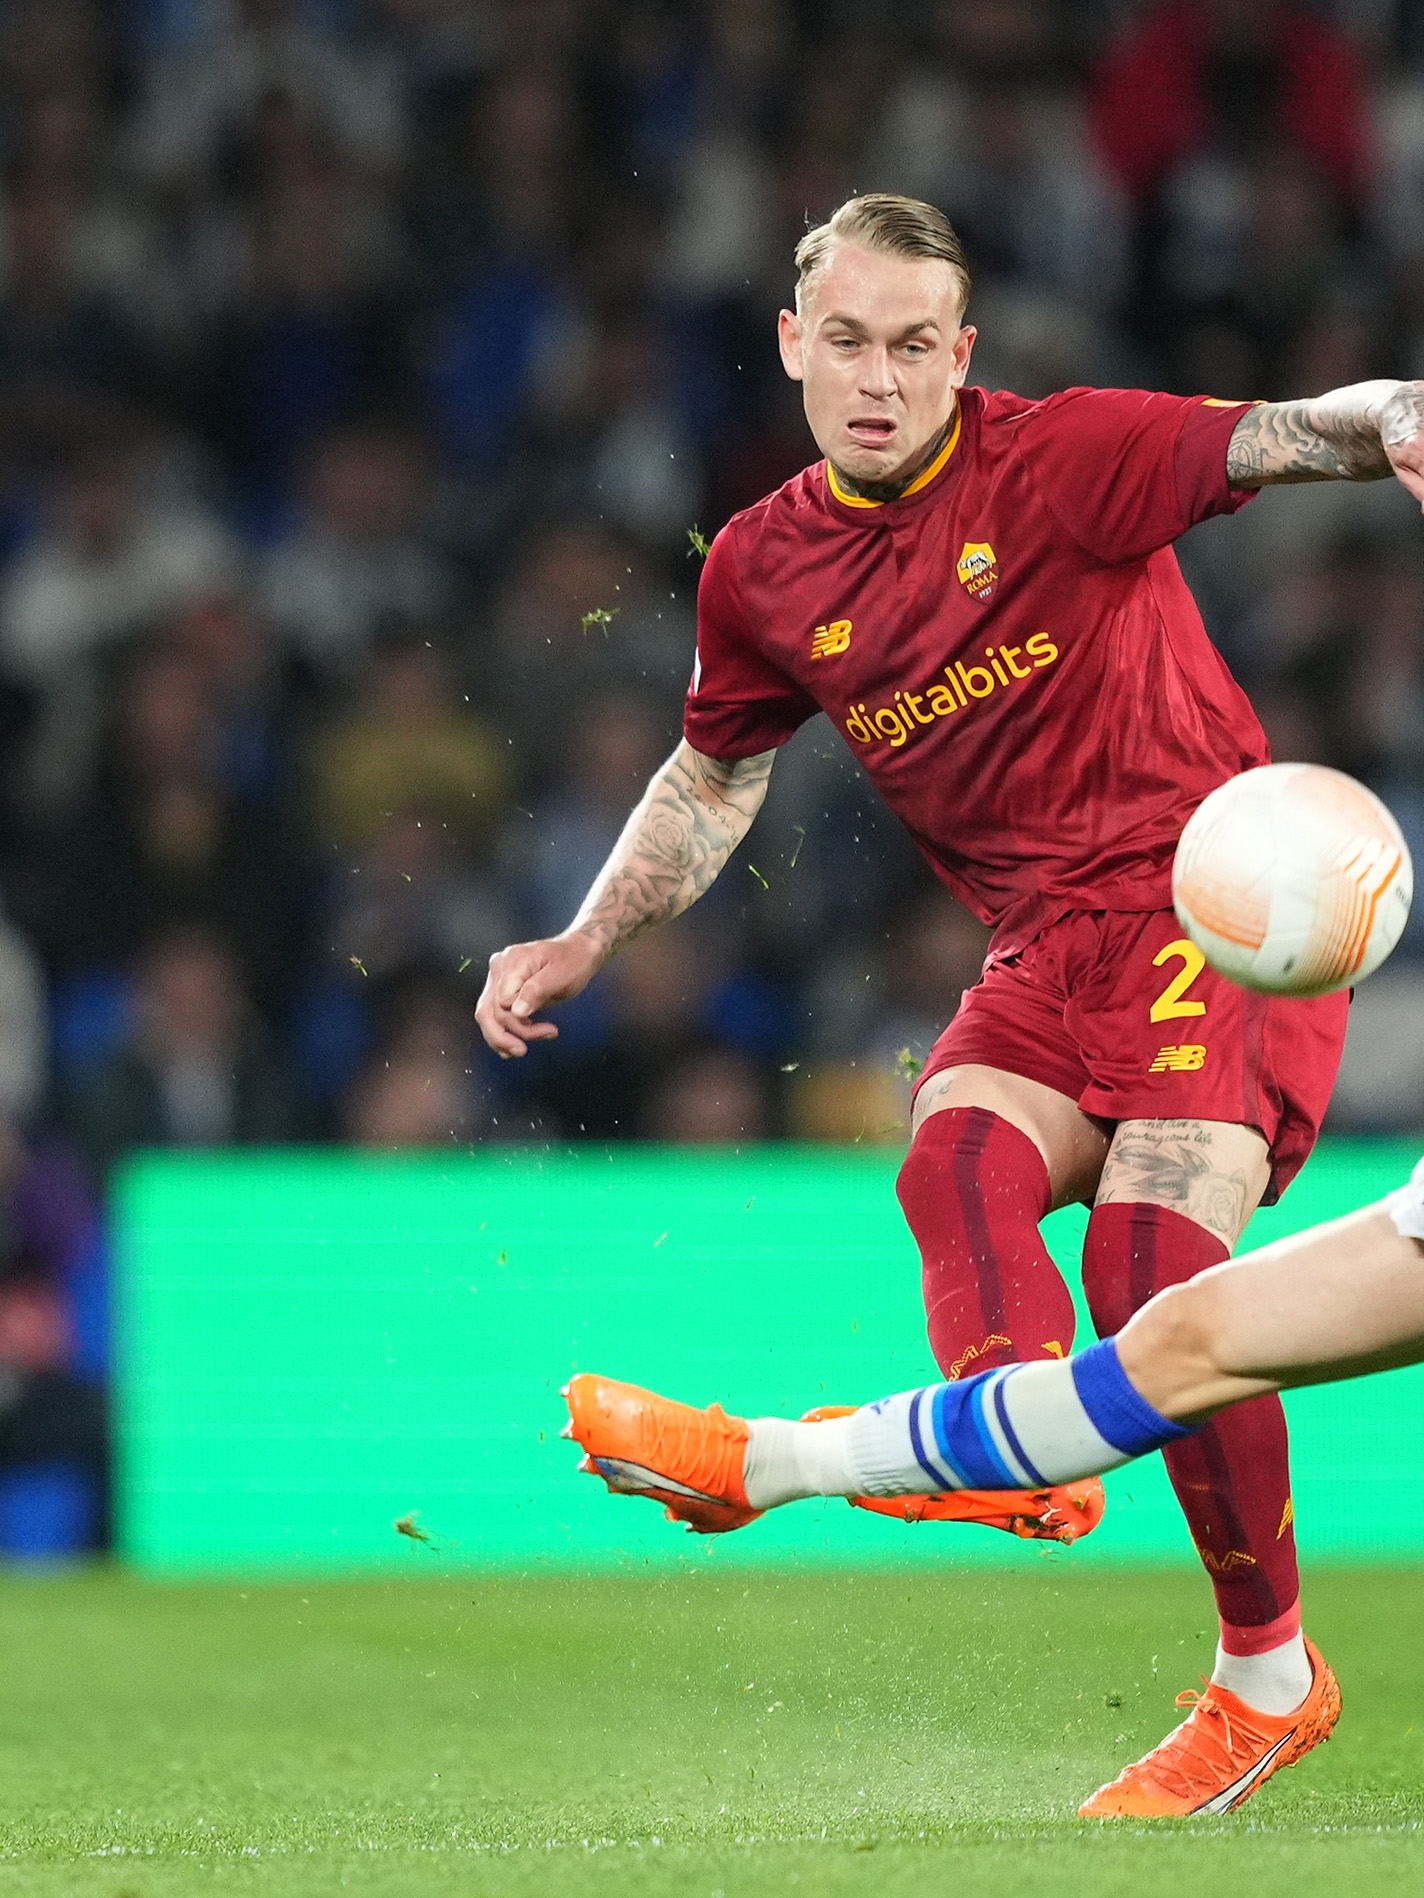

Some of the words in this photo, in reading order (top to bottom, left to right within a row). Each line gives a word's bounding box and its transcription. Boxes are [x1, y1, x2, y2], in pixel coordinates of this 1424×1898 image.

[967, 571, 998, 595] ROMA
[846, 632, 1059, 747] digitalbits
[1150, 939, 1207, 1024] 2
